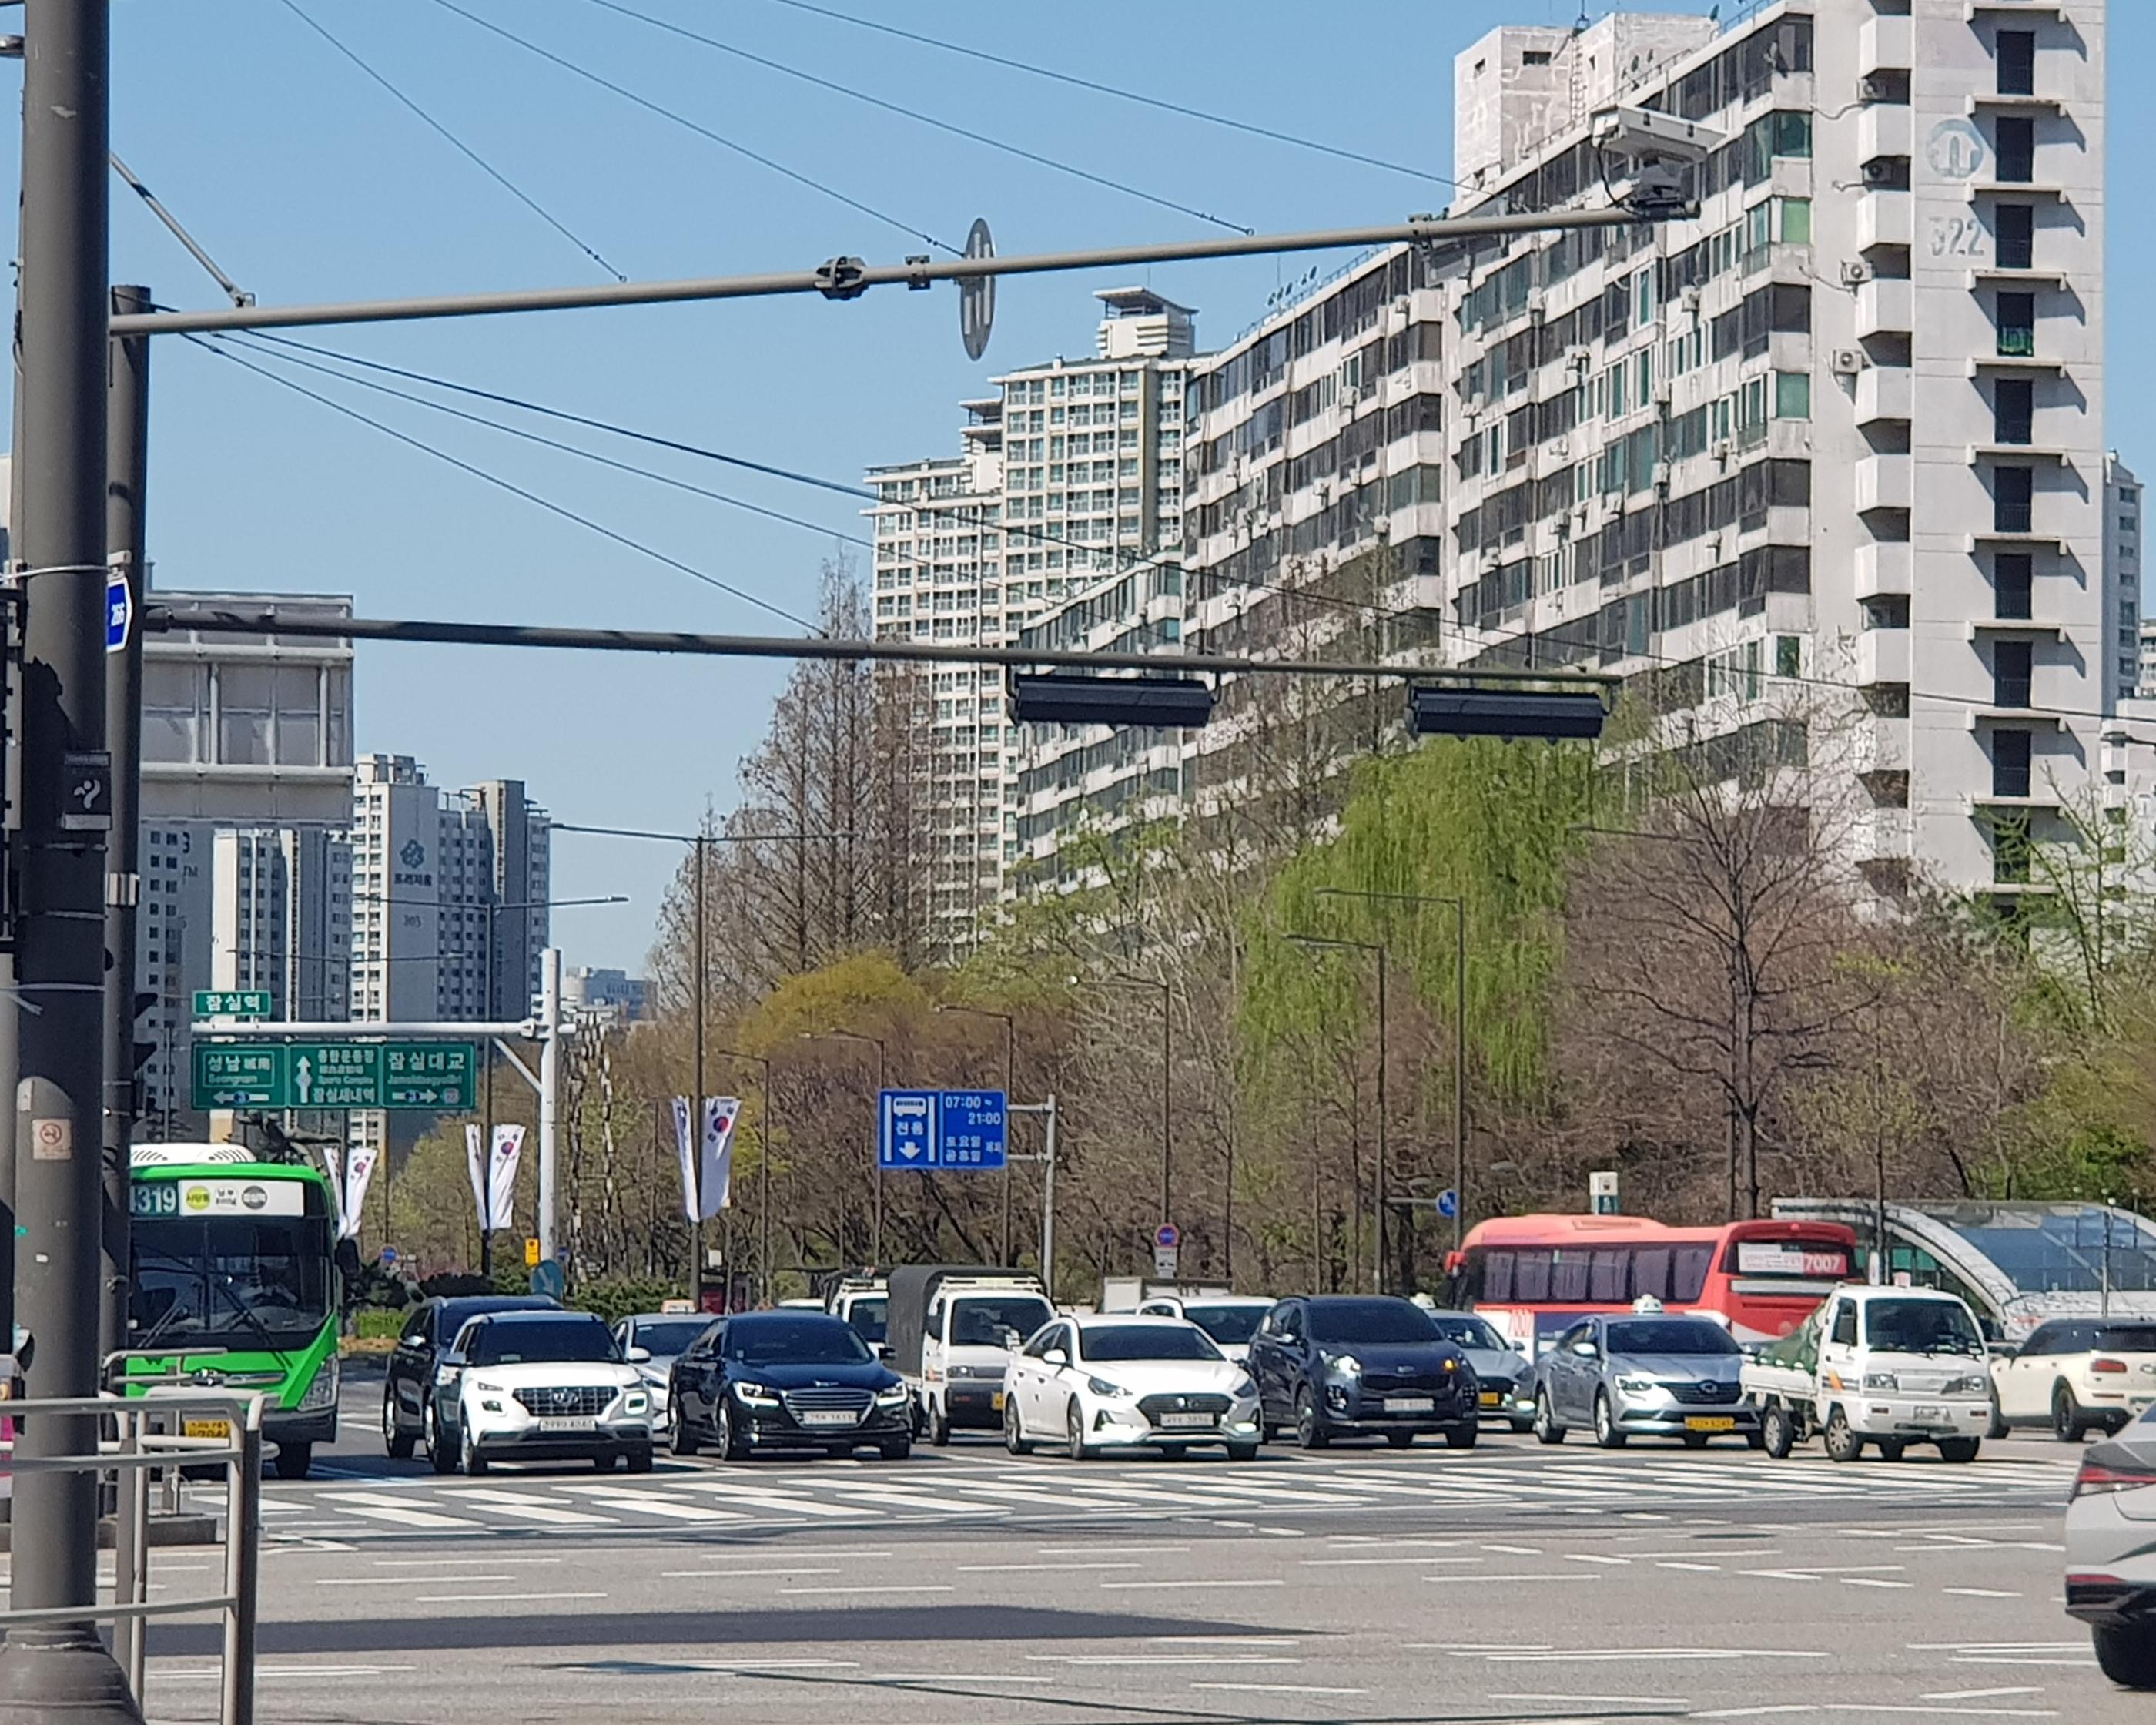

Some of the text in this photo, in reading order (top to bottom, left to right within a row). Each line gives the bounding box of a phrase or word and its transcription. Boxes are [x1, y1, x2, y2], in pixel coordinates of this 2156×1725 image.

[1928, 216, 1984, 256] 322
[206, 994, 260, 1012] 잠실역
[208, 1055, 240, 1072] 성남
[388, 1051, 465, 1070] 잠실대교
[968, 1112, 1001, 1125] 21:00
[896, 1121, 924, 1136] 전용
[946, 1136, 981, 1148] 토요일
[946, 1149, 981, 1162] 공휴일
[1804, 1254, 1840, 1271] 7007
